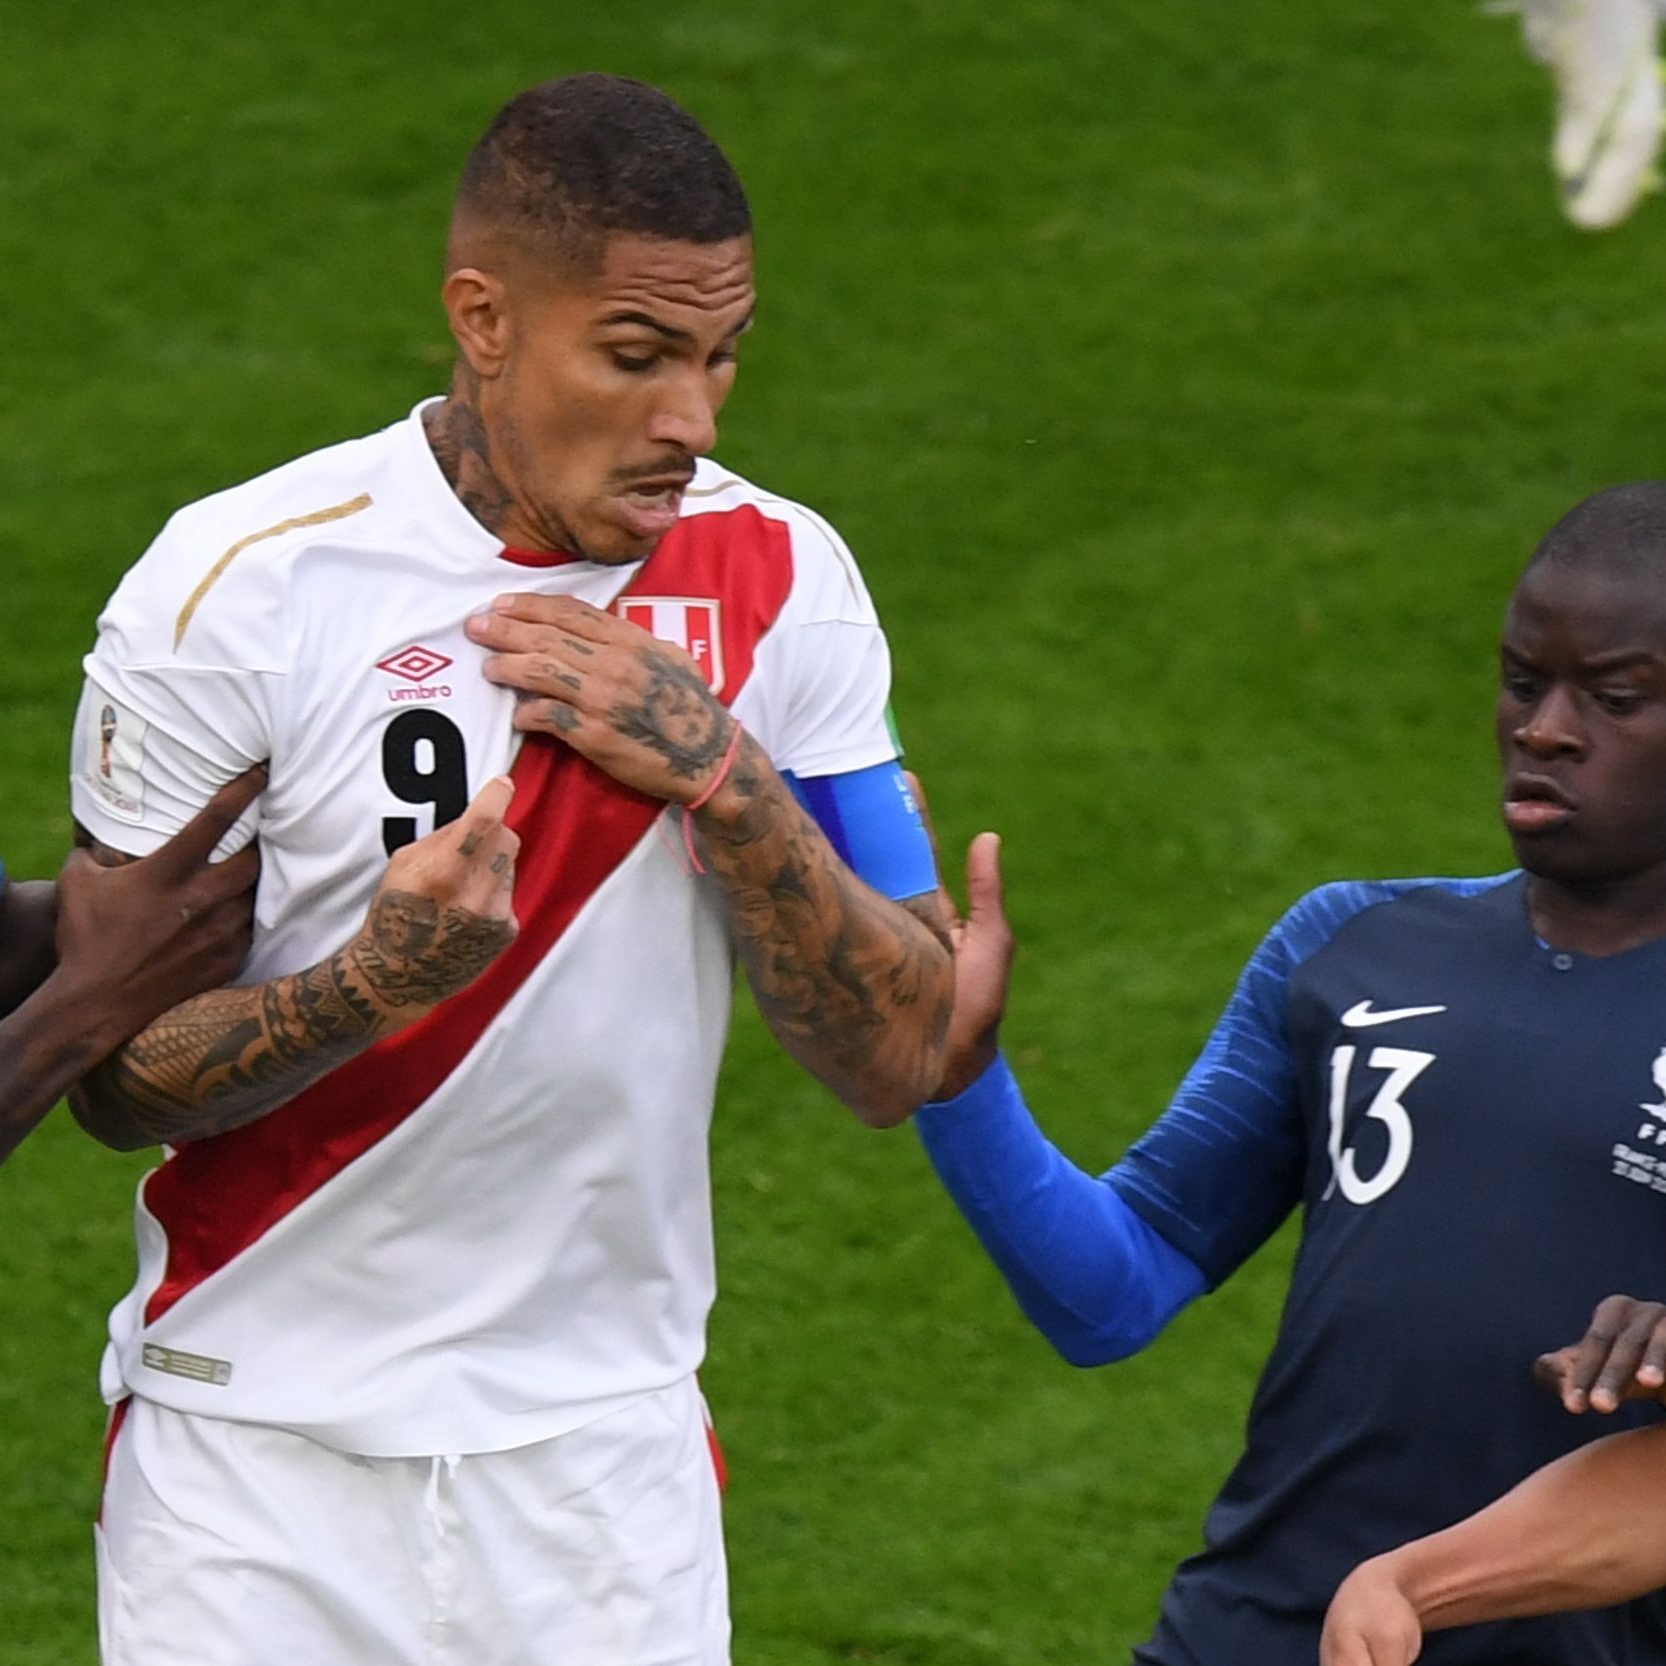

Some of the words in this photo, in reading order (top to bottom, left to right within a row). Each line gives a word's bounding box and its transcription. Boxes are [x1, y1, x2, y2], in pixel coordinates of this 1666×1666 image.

[388, 685, 452, 702] umbro
[382, 708, 469, 858] 9
[1322, 1045, 1436, 1205] 13
